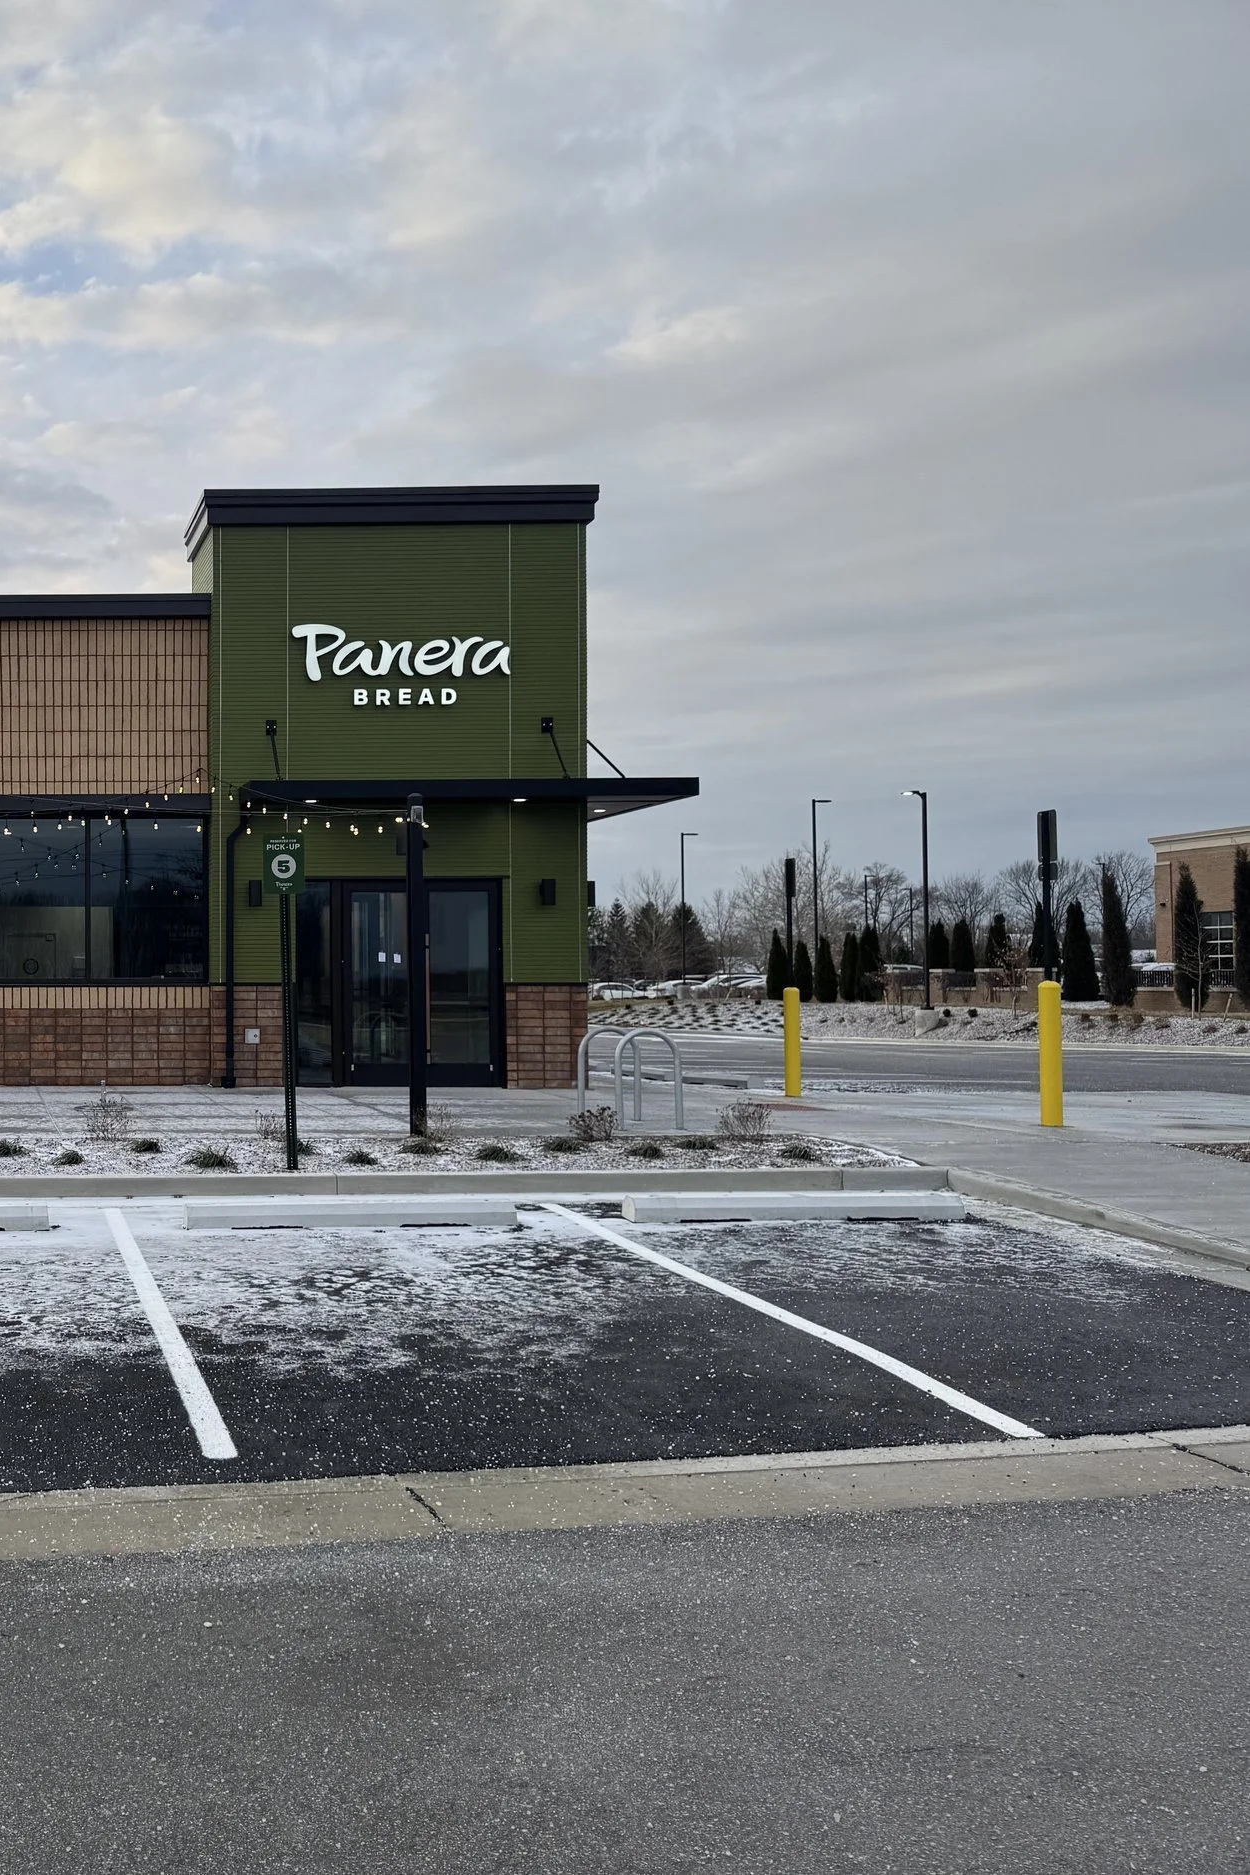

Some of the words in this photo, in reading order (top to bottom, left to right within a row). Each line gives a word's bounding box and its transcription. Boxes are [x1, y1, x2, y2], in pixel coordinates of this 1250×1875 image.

[291, 623, 511, 682] Panera
[353, 688, 457, 706] BREAD
[266, 843, 300, 851] PICK-UP
[277, 859, 290, 874] 5
